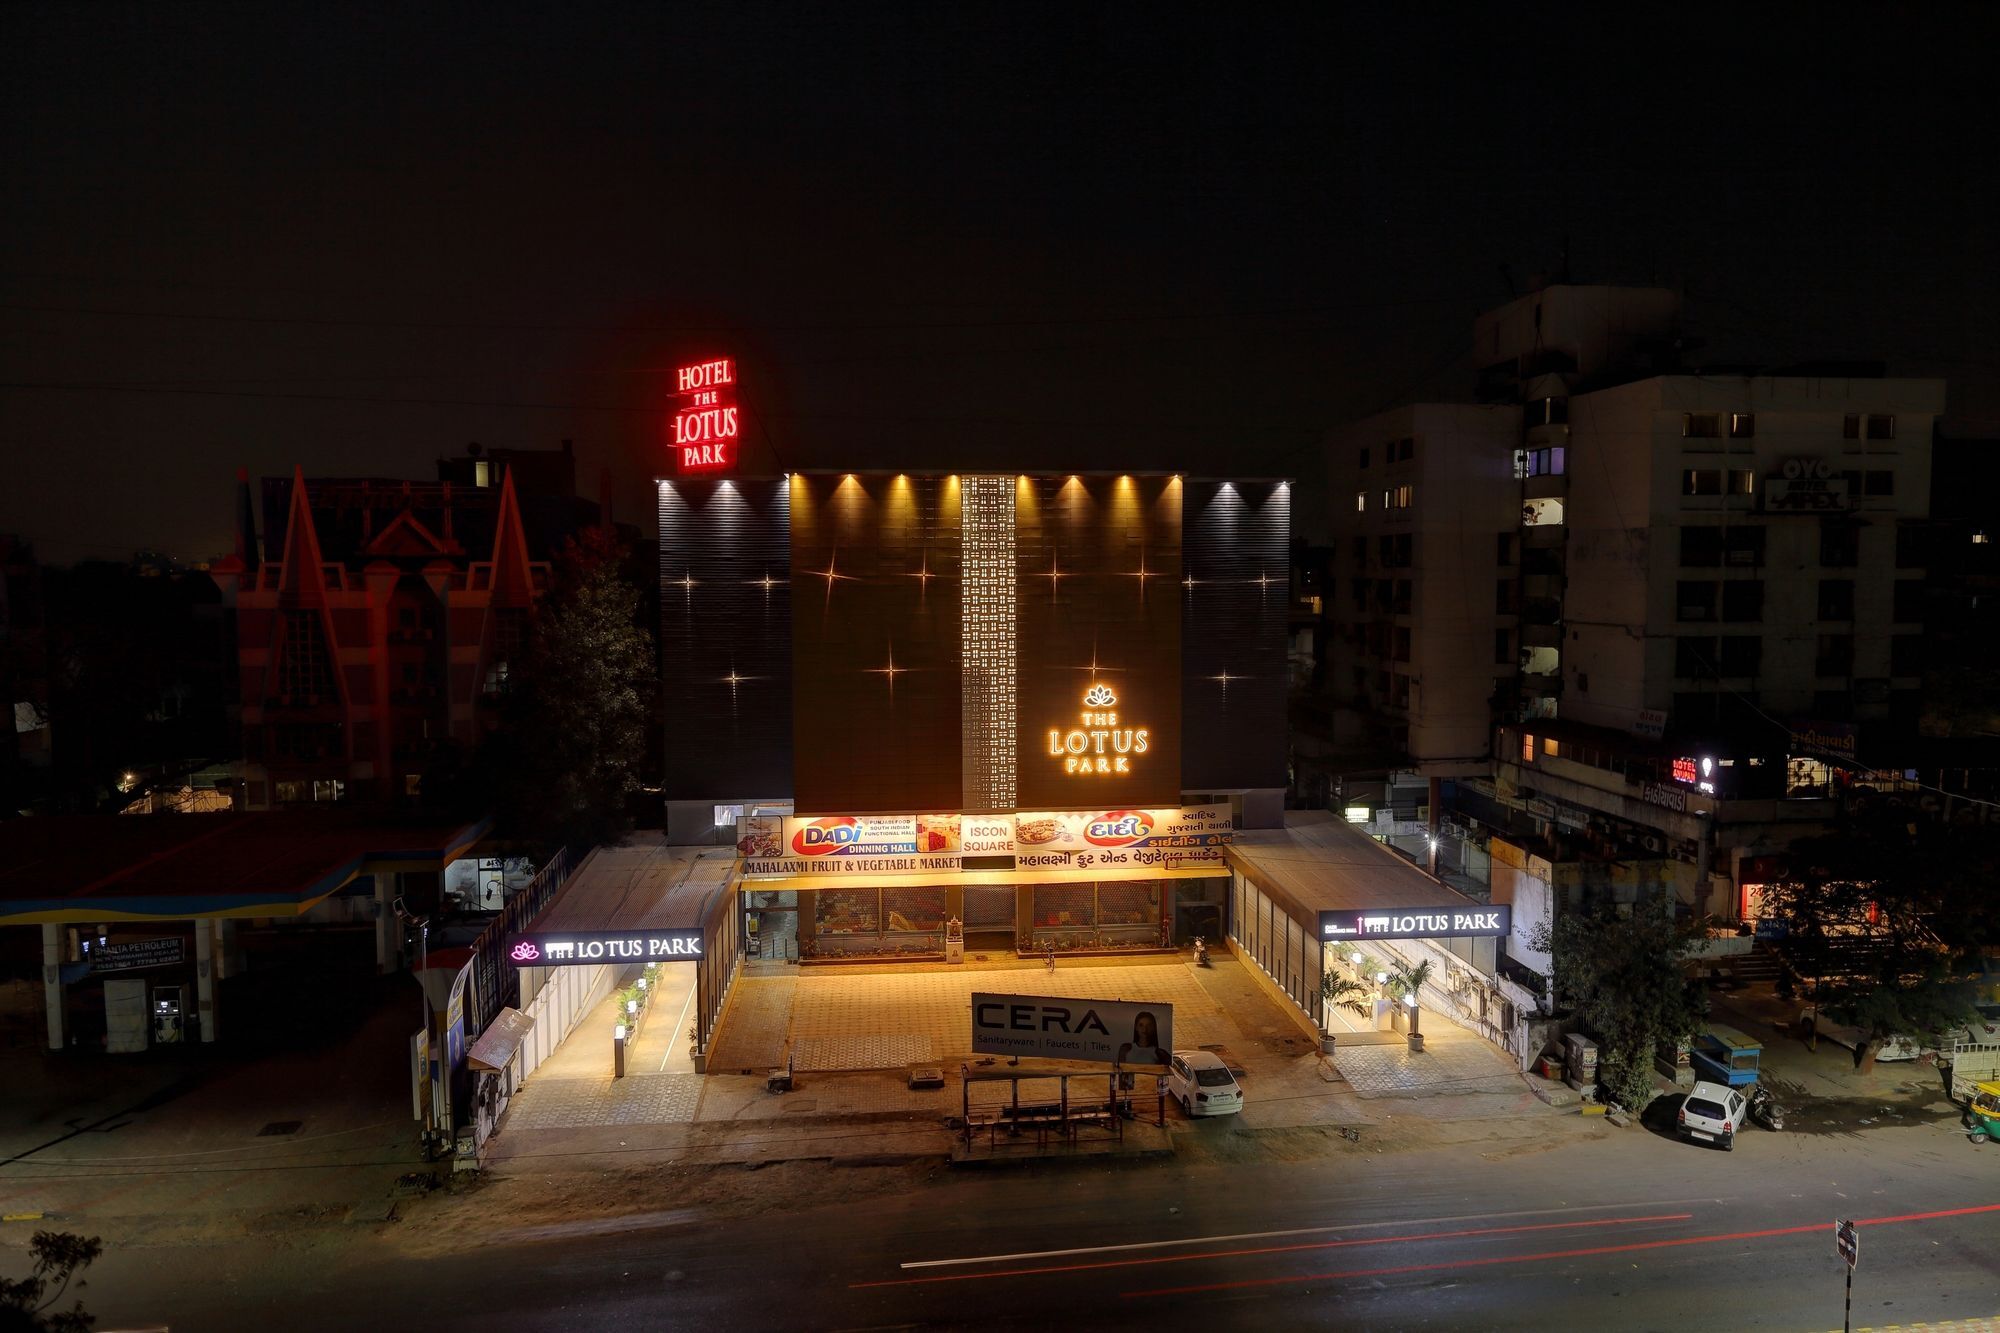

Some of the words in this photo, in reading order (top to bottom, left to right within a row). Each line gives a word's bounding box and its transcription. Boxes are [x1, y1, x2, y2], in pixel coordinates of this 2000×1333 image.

[679, 360, 731, 391] HOTEL
[694, 391, 717, 406] THE
[676, 407, 737, 443] LOTUS
[684, 444, 725, 466] PARK
[1783, 459, 1833, 480] OYO
[1082, 713, 1117, 726] THE
[1050, 730, 1148, 754] LOTUS
[1067, 757, 1130, 773] PARK
[1673, 759, 1696, 772] HOTEL
[970, 827, 1007, 837] ISCON
[1167, 822, 1204, 834] ગુજરાતી
[849, 845, 888, 854] DINNING
[890, 843, 914, 852] HALL
[964, 841, 1014, 852] SQUARE
[747, 861, 808, 873] MAHALAXMI
[812, 861, 841, 872] FRUIT
[845, 860, 854, 872] &
[857, 859, 916, 871] VEGETABLE
[920, 857, 960, 869] MARKET
[1392, 915, 1449, 932] LOTUS
[1454, 913, 1500, 930] PARK
[128, 939, 178, 952] PETROLEUM
[578, 939, 643, 958] LOTUS
[649, 938, 702, 955] PARK
[977, 1003, 1110, 1036] CERA
[977, 1035, 1035, 1048] Sanitaryware
[1046, 1040, 1080, 1050] Faucets
[1091, 1041, 1111, 1052] Tiles
